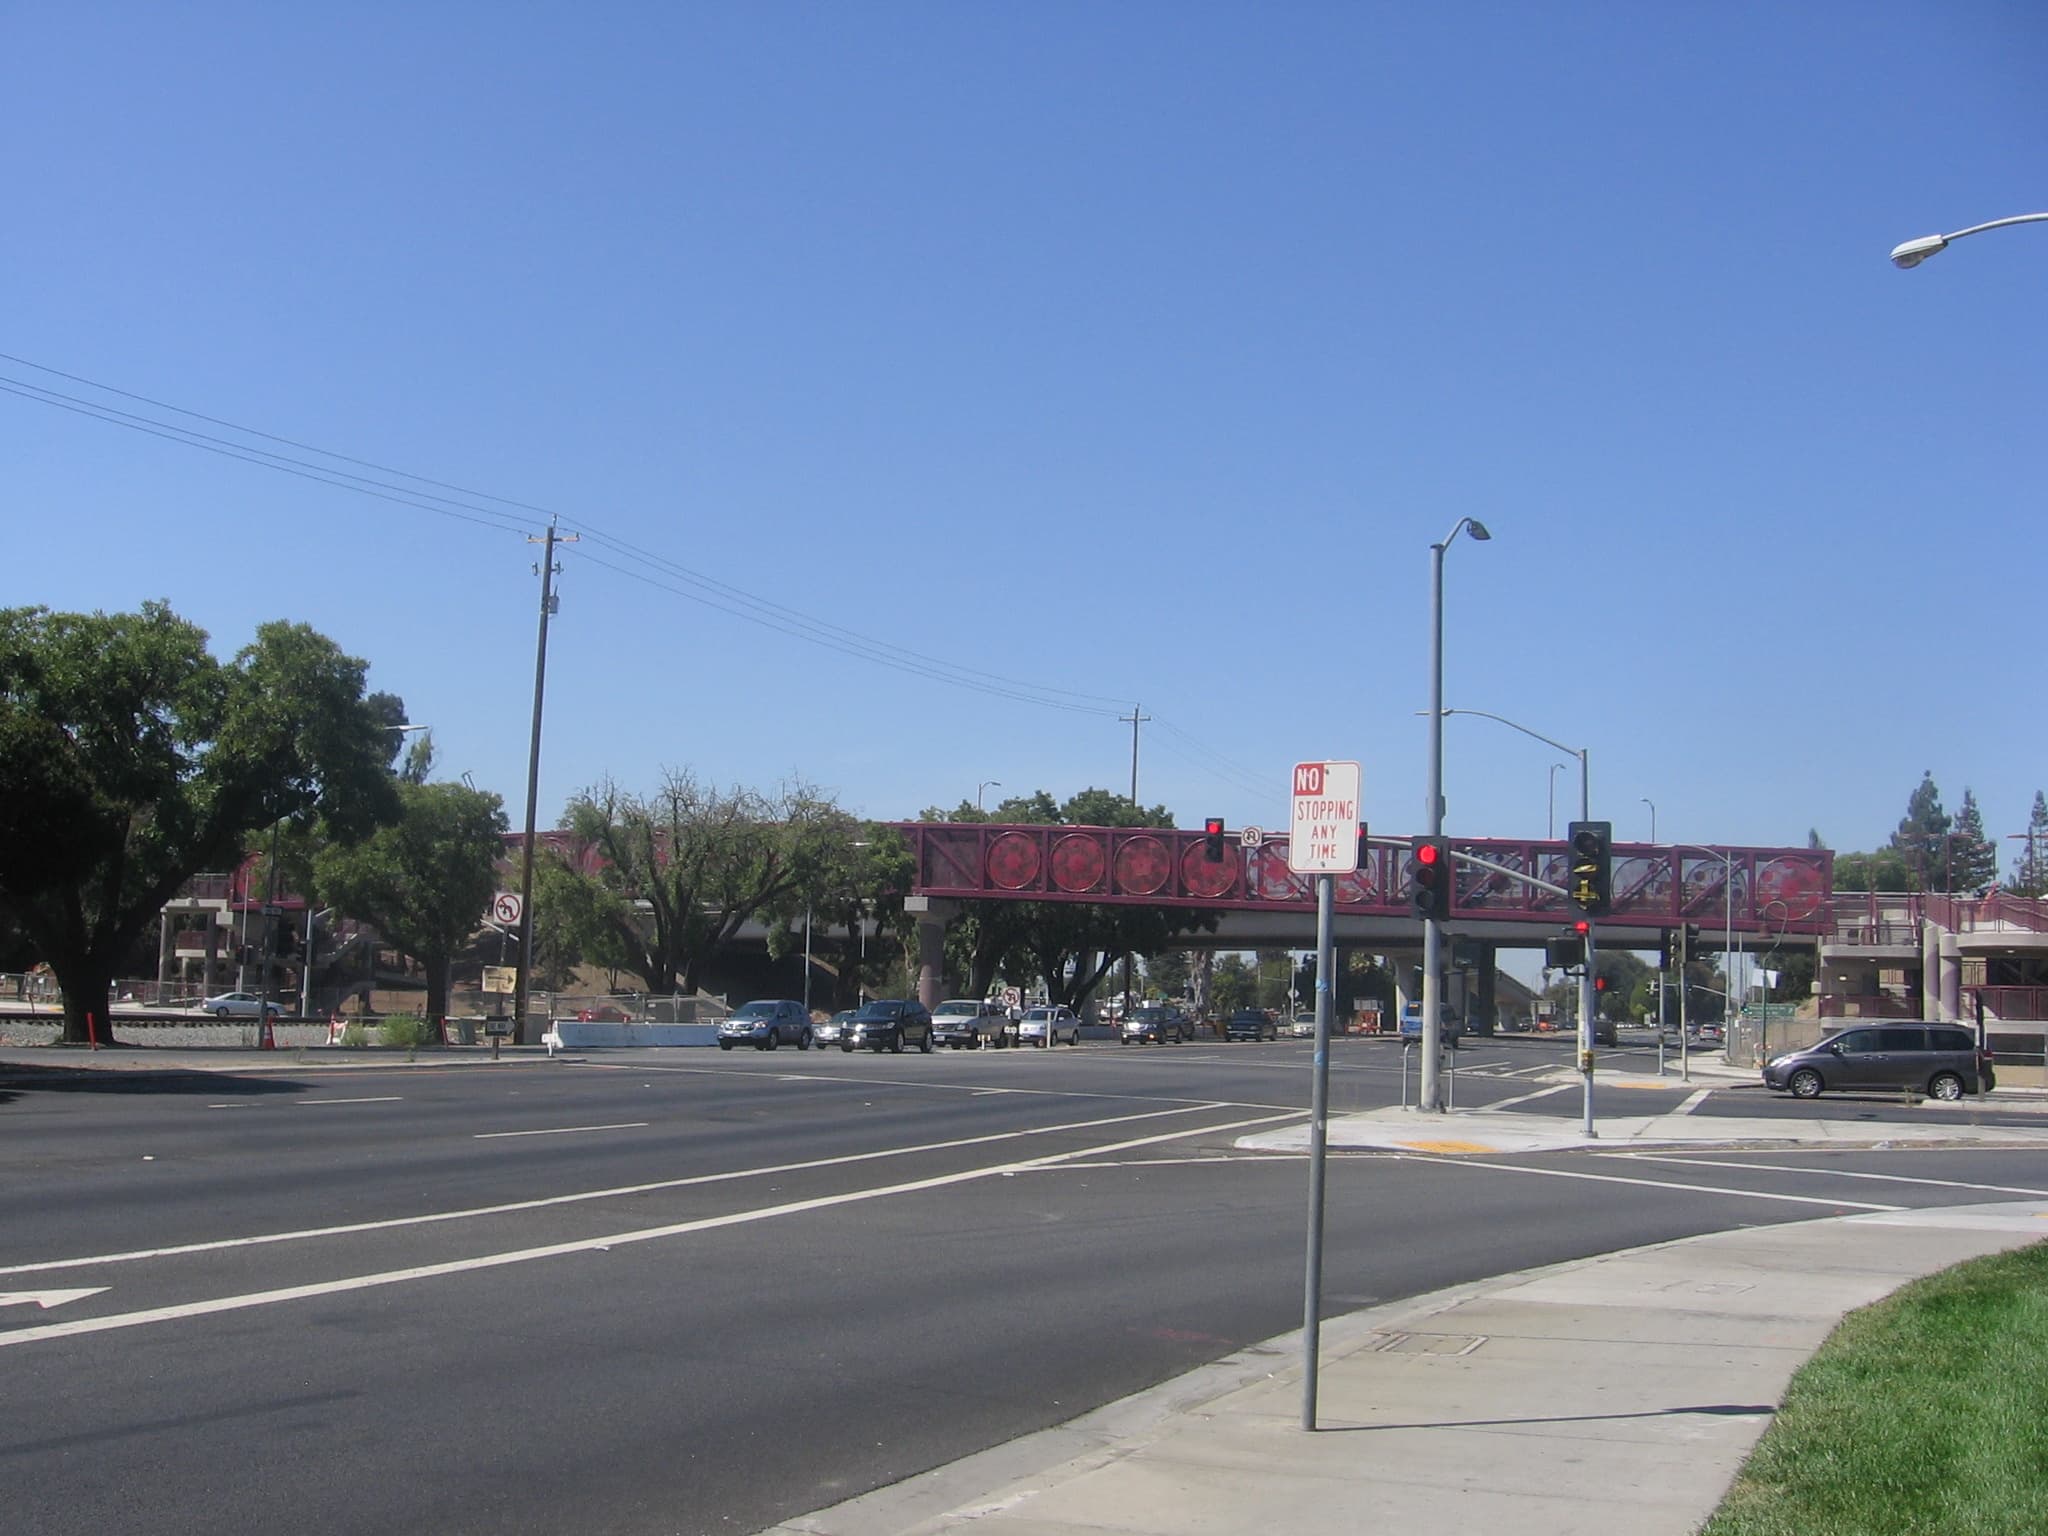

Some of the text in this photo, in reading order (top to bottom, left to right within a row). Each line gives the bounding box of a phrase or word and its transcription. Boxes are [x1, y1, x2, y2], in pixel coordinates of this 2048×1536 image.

[1297, 767, 1319, 791] NO
[1297, 800, 1353, 820] STOPPING
[1311, 824, 1337, 839] ANY
[1310, 843, 1336, 859] TIME
